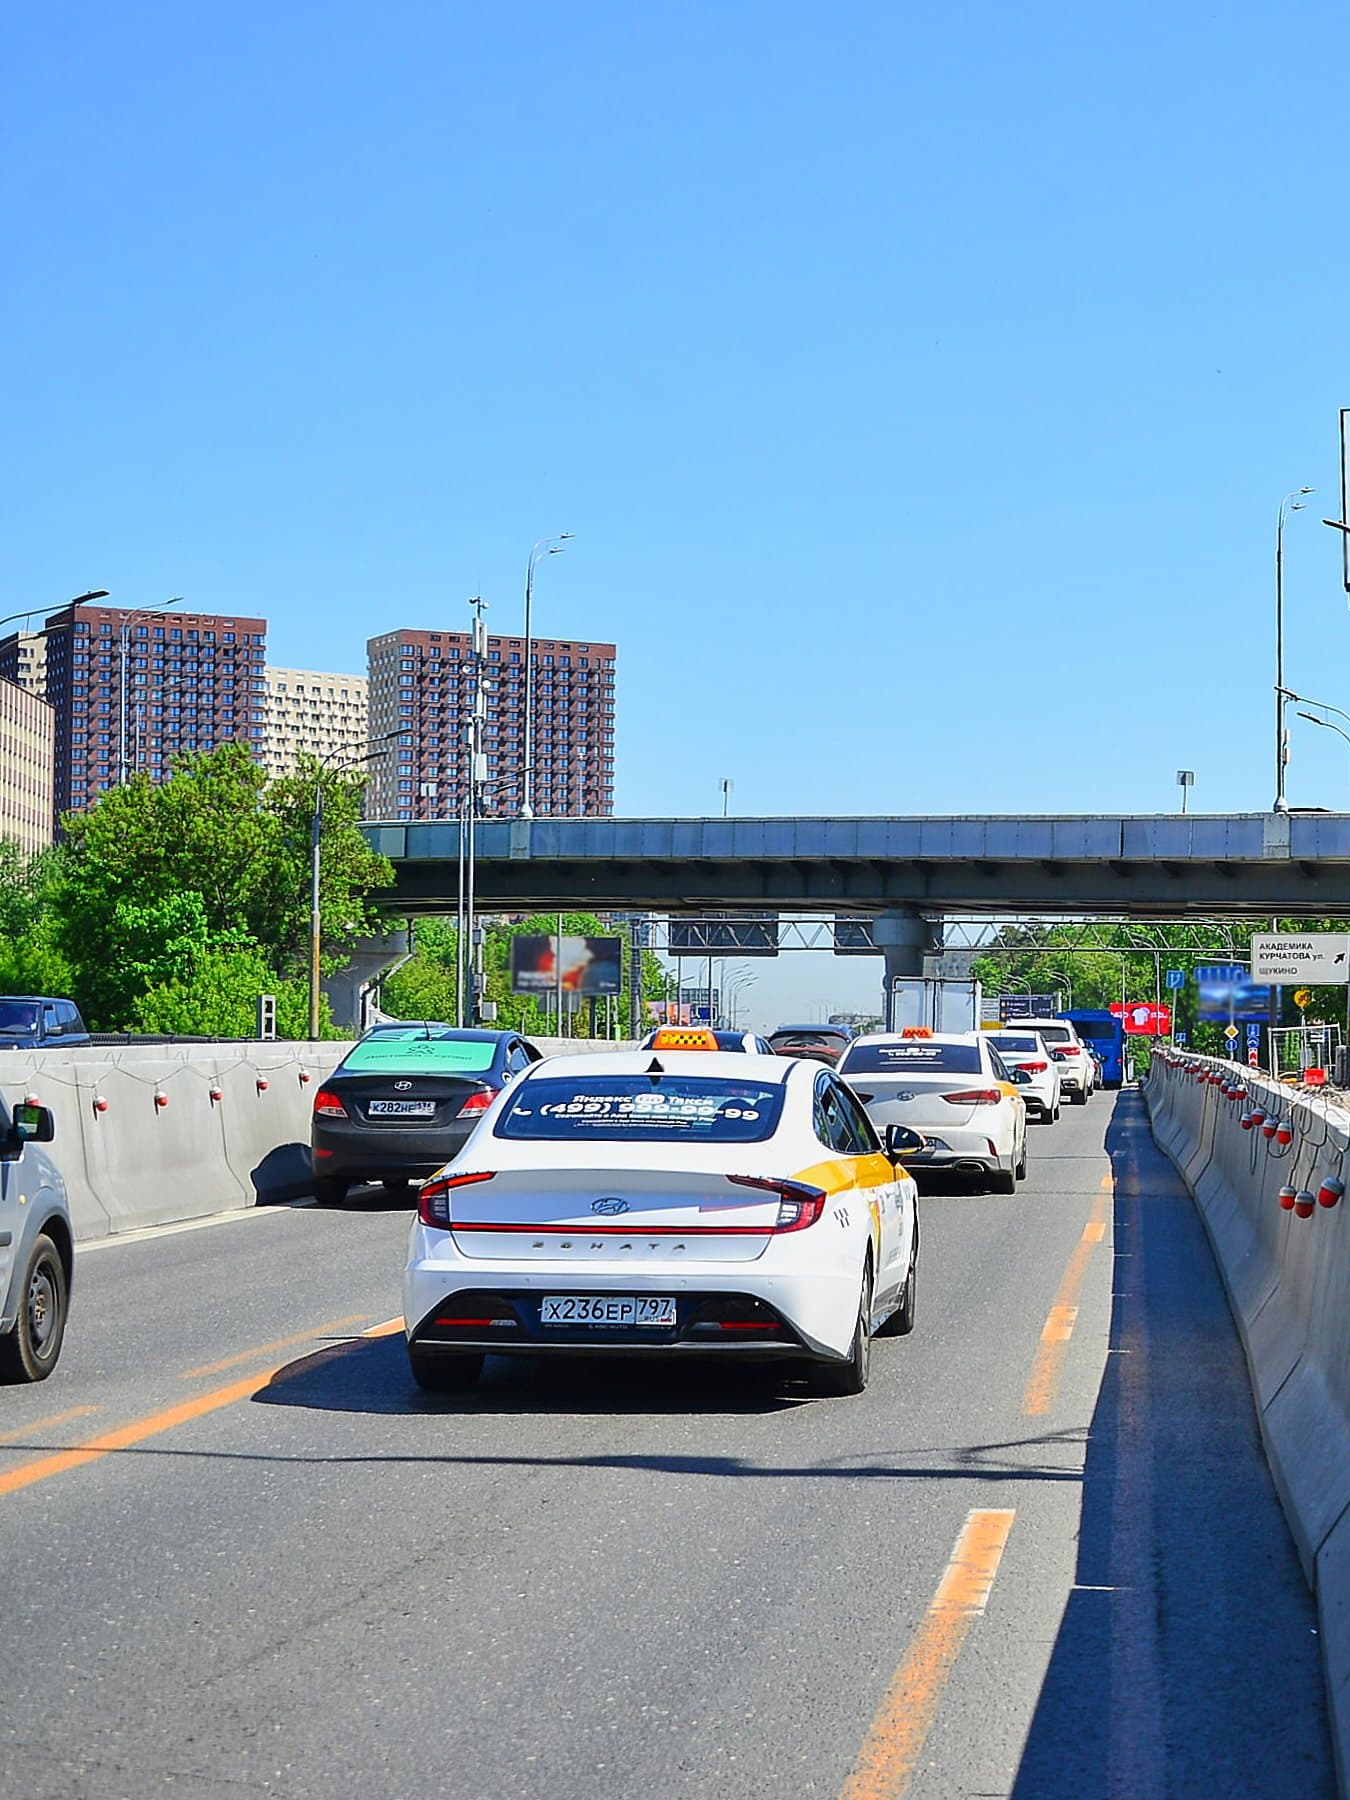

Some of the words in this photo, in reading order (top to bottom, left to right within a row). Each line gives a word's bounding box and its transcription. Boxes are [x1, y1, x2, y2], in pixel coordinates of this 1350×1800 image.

[1259, 942, 1314, 951] АКАДЕМИКА
[1259, 952, 1311, 960] КУРЧАТОВА
[1259, 967, 1298, 975] ЩУКИНО
[572, 1095, 632, 1103] Яндекс
[669, 1096, 714, 1105] Такси
[540, 1103, 611, 1115] (499)
[618, 1103, 760, 1121] 999-99-99
[549, 1299, 632, 1321] Х236ЕР
[638, 1299, 671, 1316] 797
